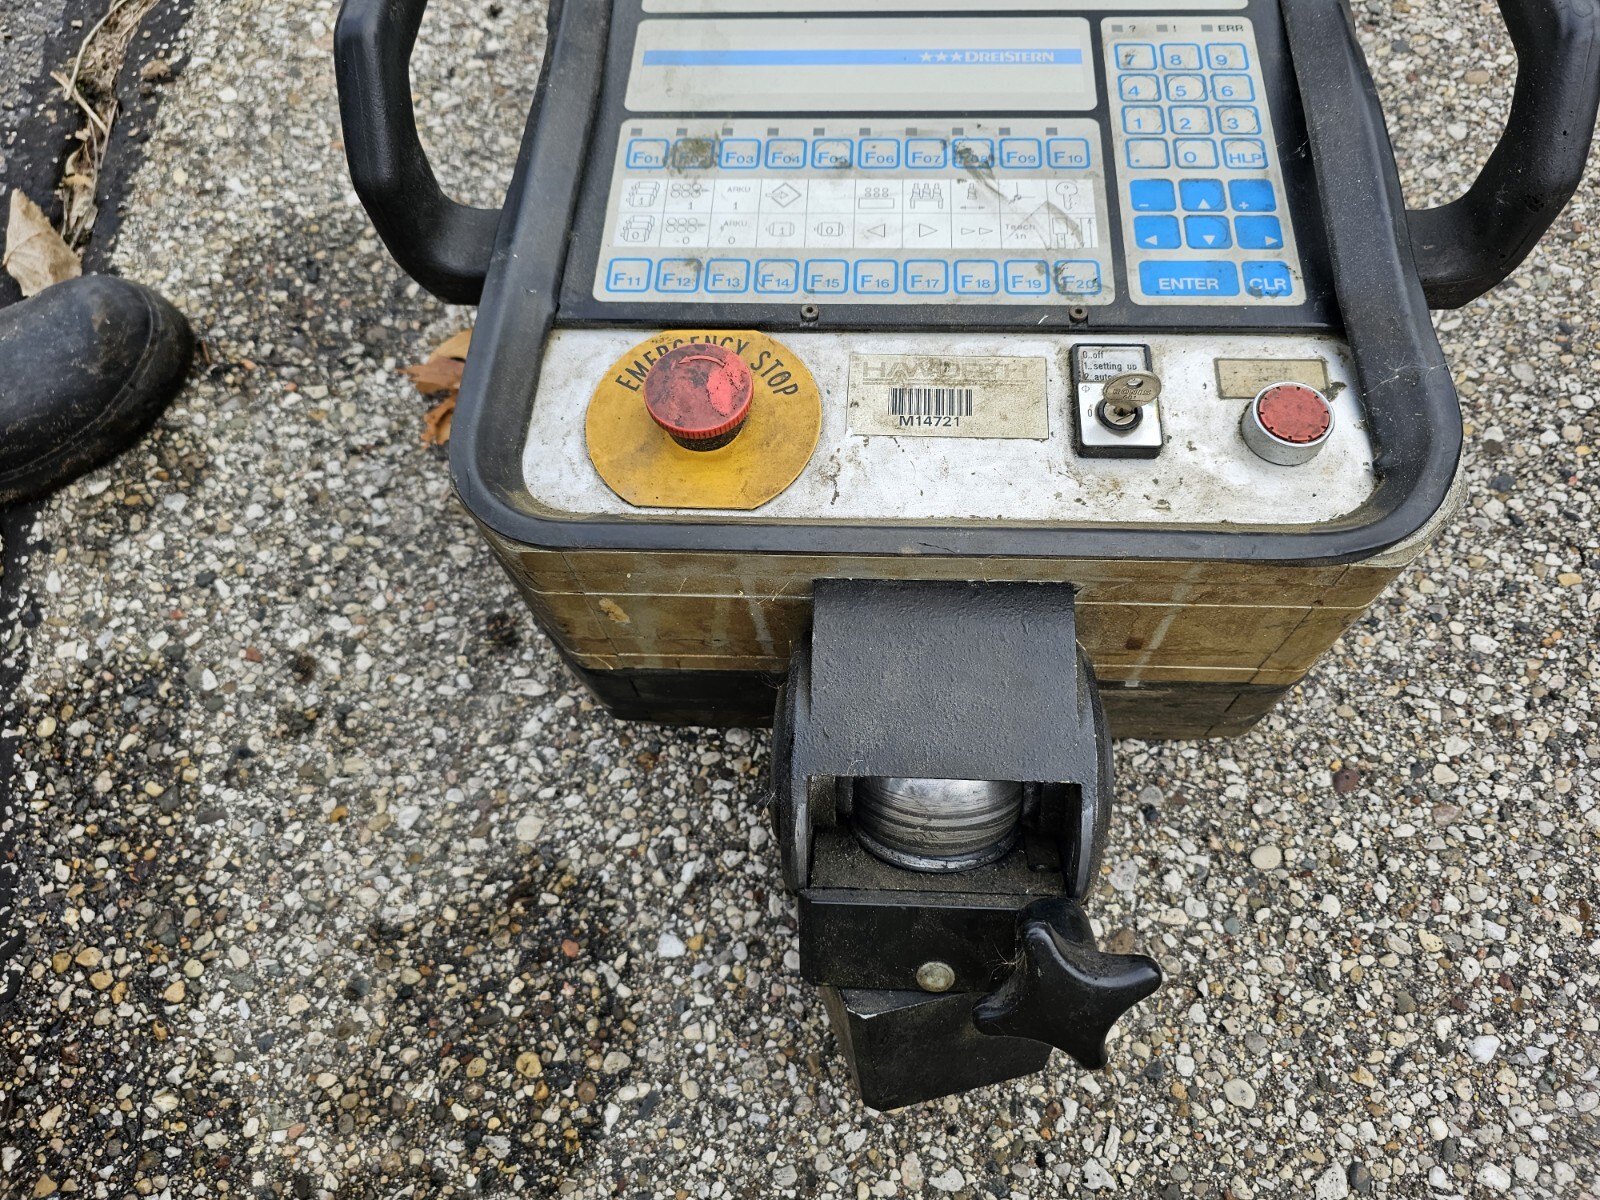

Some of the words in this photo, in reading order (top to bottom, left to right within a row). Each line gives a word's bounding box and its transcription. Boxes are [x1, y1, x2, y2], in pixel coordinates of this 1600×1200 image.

[965, 51, 1055, 62] DREISTERN
[1126, 54, 1136, 65] 7
[1170, 54, 1182, 66] 8
[1216, 54, 1228, 66] 9
[1128, 86, 1140, 96] 4
[1176, 86, 1187, 96] 5
[1221, 86, 1234, 97] 6
[1134, 118, 1142, 129] 1
[1179, 118, 1192, 130] 2
[1226, 118, 1239, 130] 3
[632, 152, 660, 164] F01
[725, 152, 754, 164] F03
[771, 152, 800, 164] F04
[865, 152, 894, 164] F06
[912, 152, 941, 164] F07
[1006, 152, 1036, 164] F09
[1054, 152, 1083, 164] F10
[1184, 152, 1196, 163] 0
[1230, 153, 1262, 163] HLP
[614, 273, 640, 286] F11
[662, 274, 691, 286] F12
[712, 274, 740, 288] F13
[761, 274, 790, 288] F14
[811, 275, 840, 288] F15
[860, 275, 890, 288] F16
[910, 275, 940, 288] F17
[961, 275, 990, 288] F18
[1012, 276, 1042, 288] F19
[1061, 276, 1095, 288] F20
[1158, 278, 1219, 290] ENTER
[1250, 278, 1286, 290] CLR
[751, 351, 799, 396] STOP
[899, 416, 960, 426] M14721
